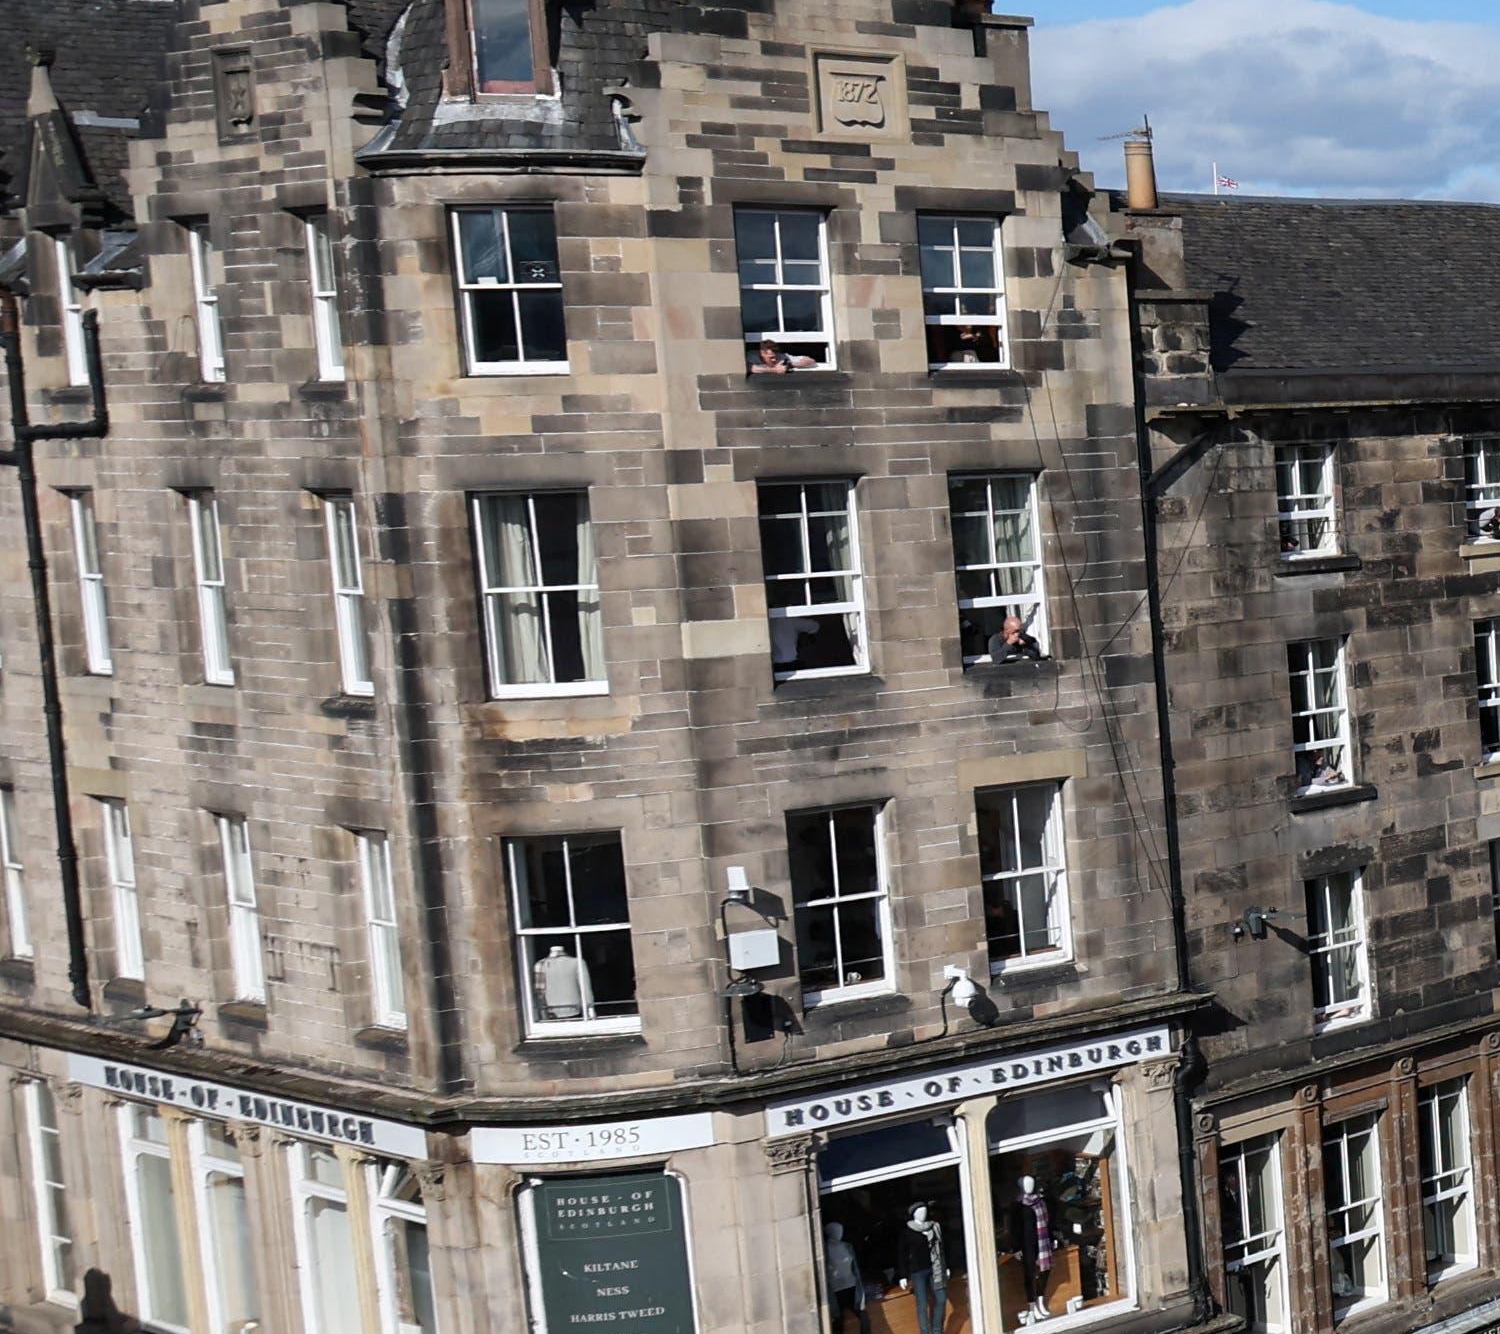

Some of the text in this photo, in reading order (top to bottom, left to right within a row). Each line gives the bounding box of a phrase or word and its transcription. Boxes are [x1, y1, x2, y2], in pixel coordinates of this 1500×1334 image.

[838, 80, 879, 105] 1872
[785, 1035, 1163, 1128] HOUSE OF EDINBURGH
[104, 1066, 377, 1146] HOUSE OF EDINBURGH
[587, 1126, 640, 1147] 1985
[556, 1191, 653, 1206] HOUSE OF
[558, 1203, 655, 1218] EDINBURGH
[559, 1217, 655, 1230] SCOTLAND
[584, 1260, 639, 1273] KILTANE
[597, 1286, 630, 1297] NESS
[570, 1307, 665, 1323] HARRIS TWEED
